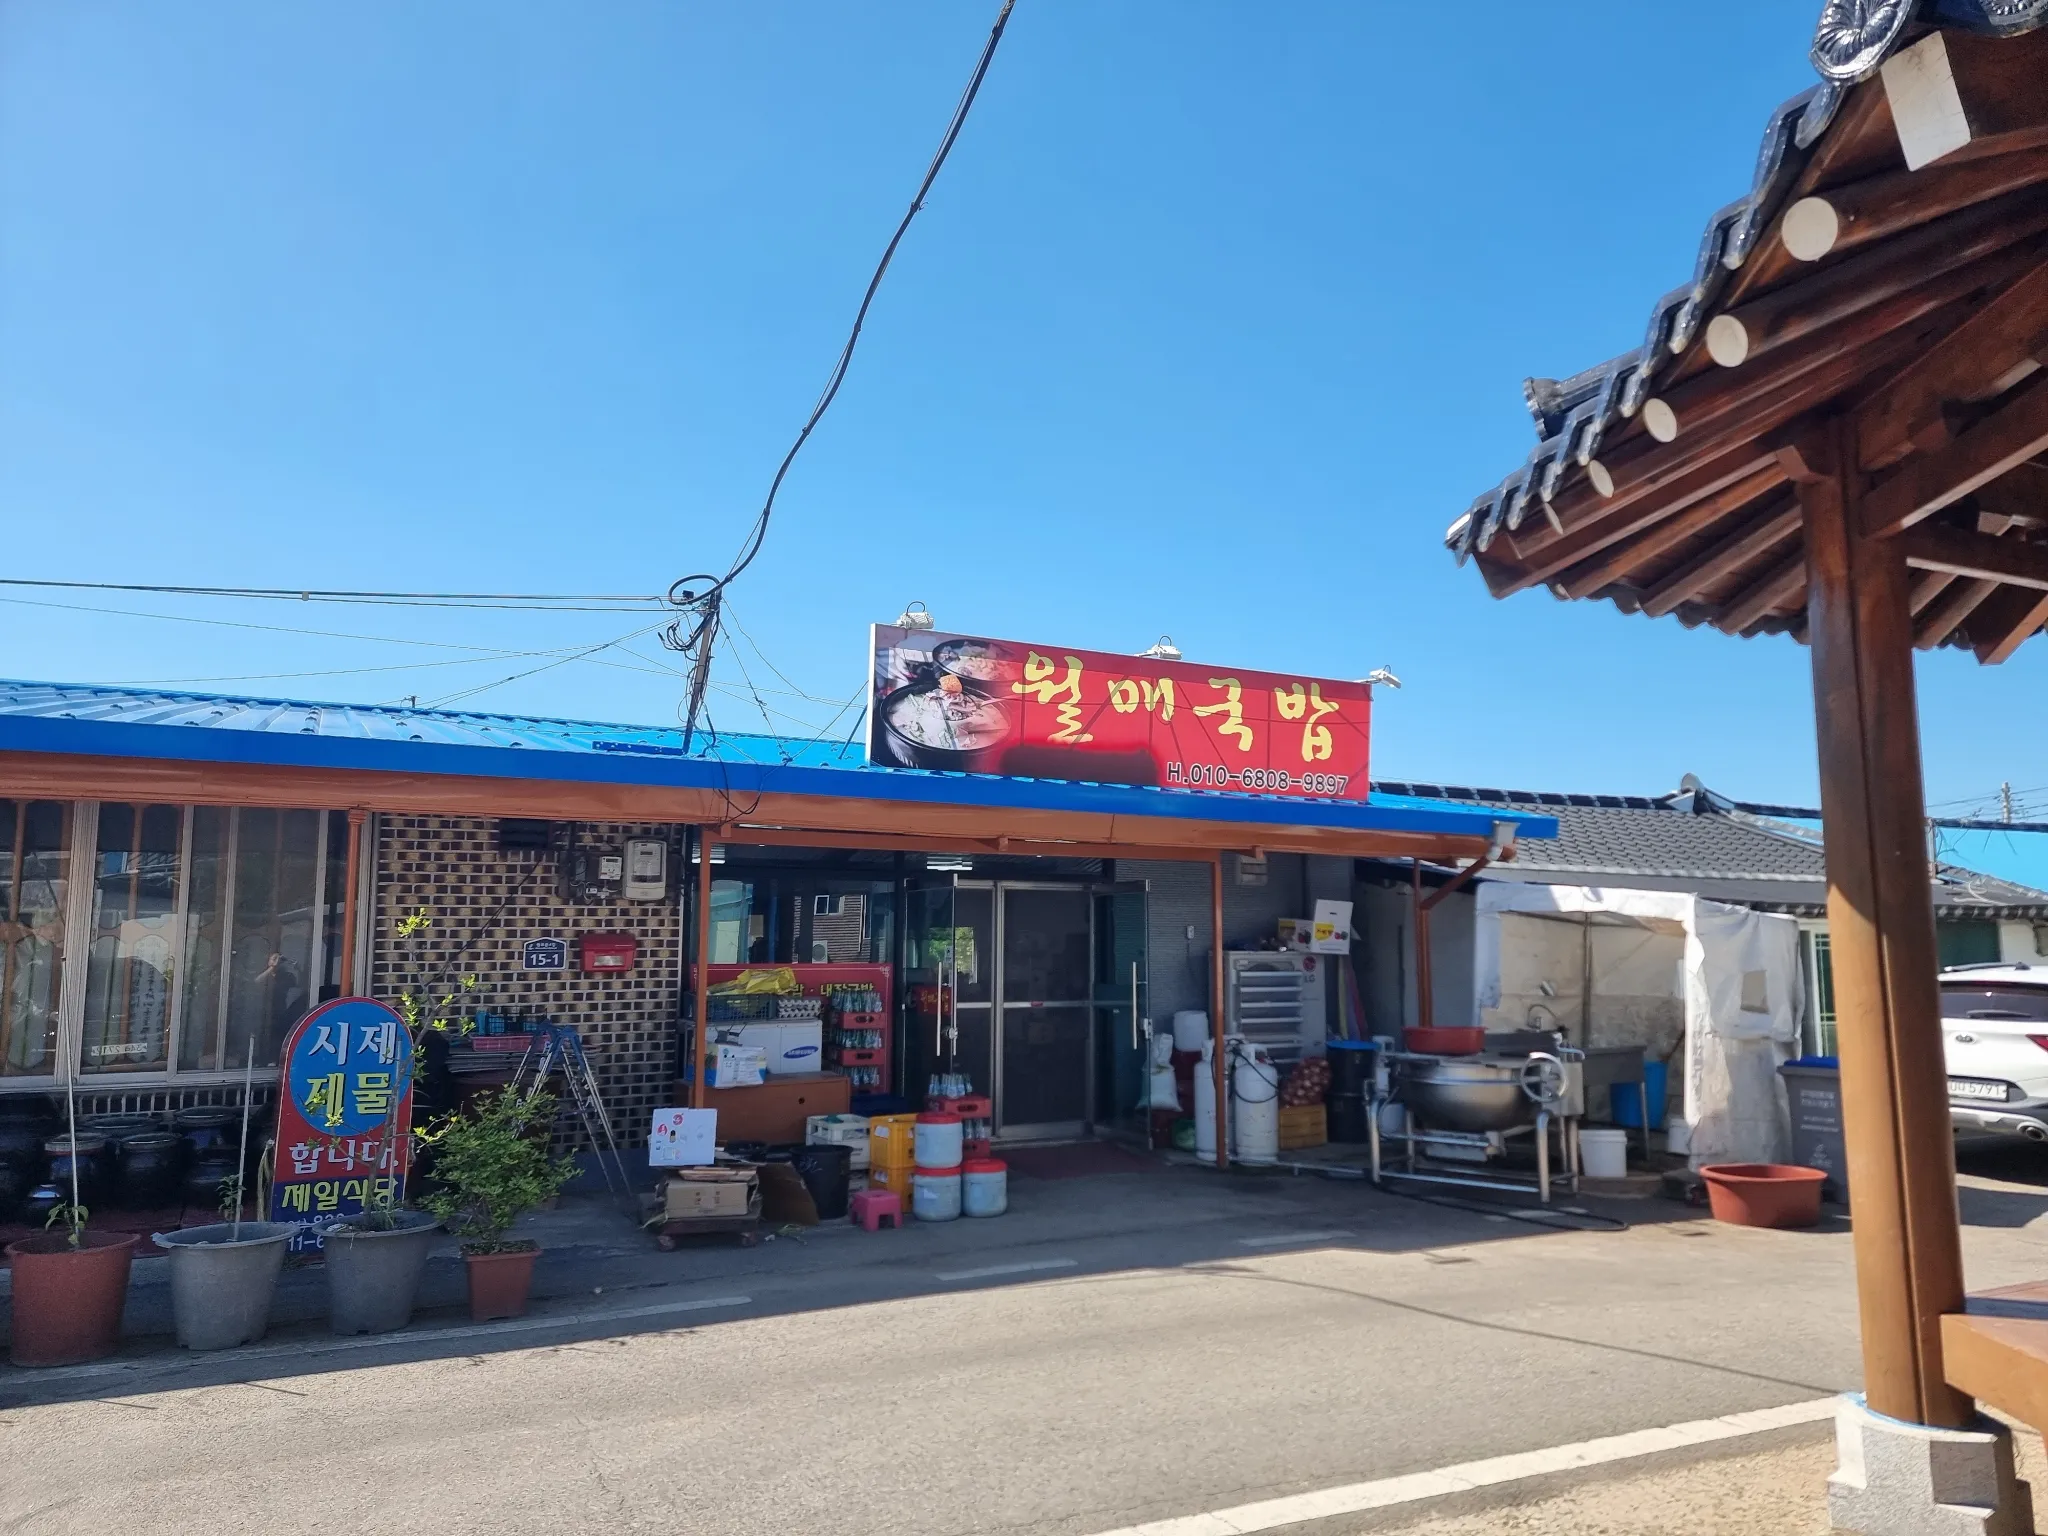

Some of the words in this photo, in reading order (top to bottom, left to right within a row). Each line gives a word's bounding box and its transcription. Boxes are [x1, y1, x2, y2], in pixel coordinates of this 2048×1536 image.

[1167, 762, 1348, 794] H.010-6808-9897
[530, 953, 559, 965] 15-1
[308, 1021, 397, 1066] 시제
[304, 1072, 393, 1116] 제물
